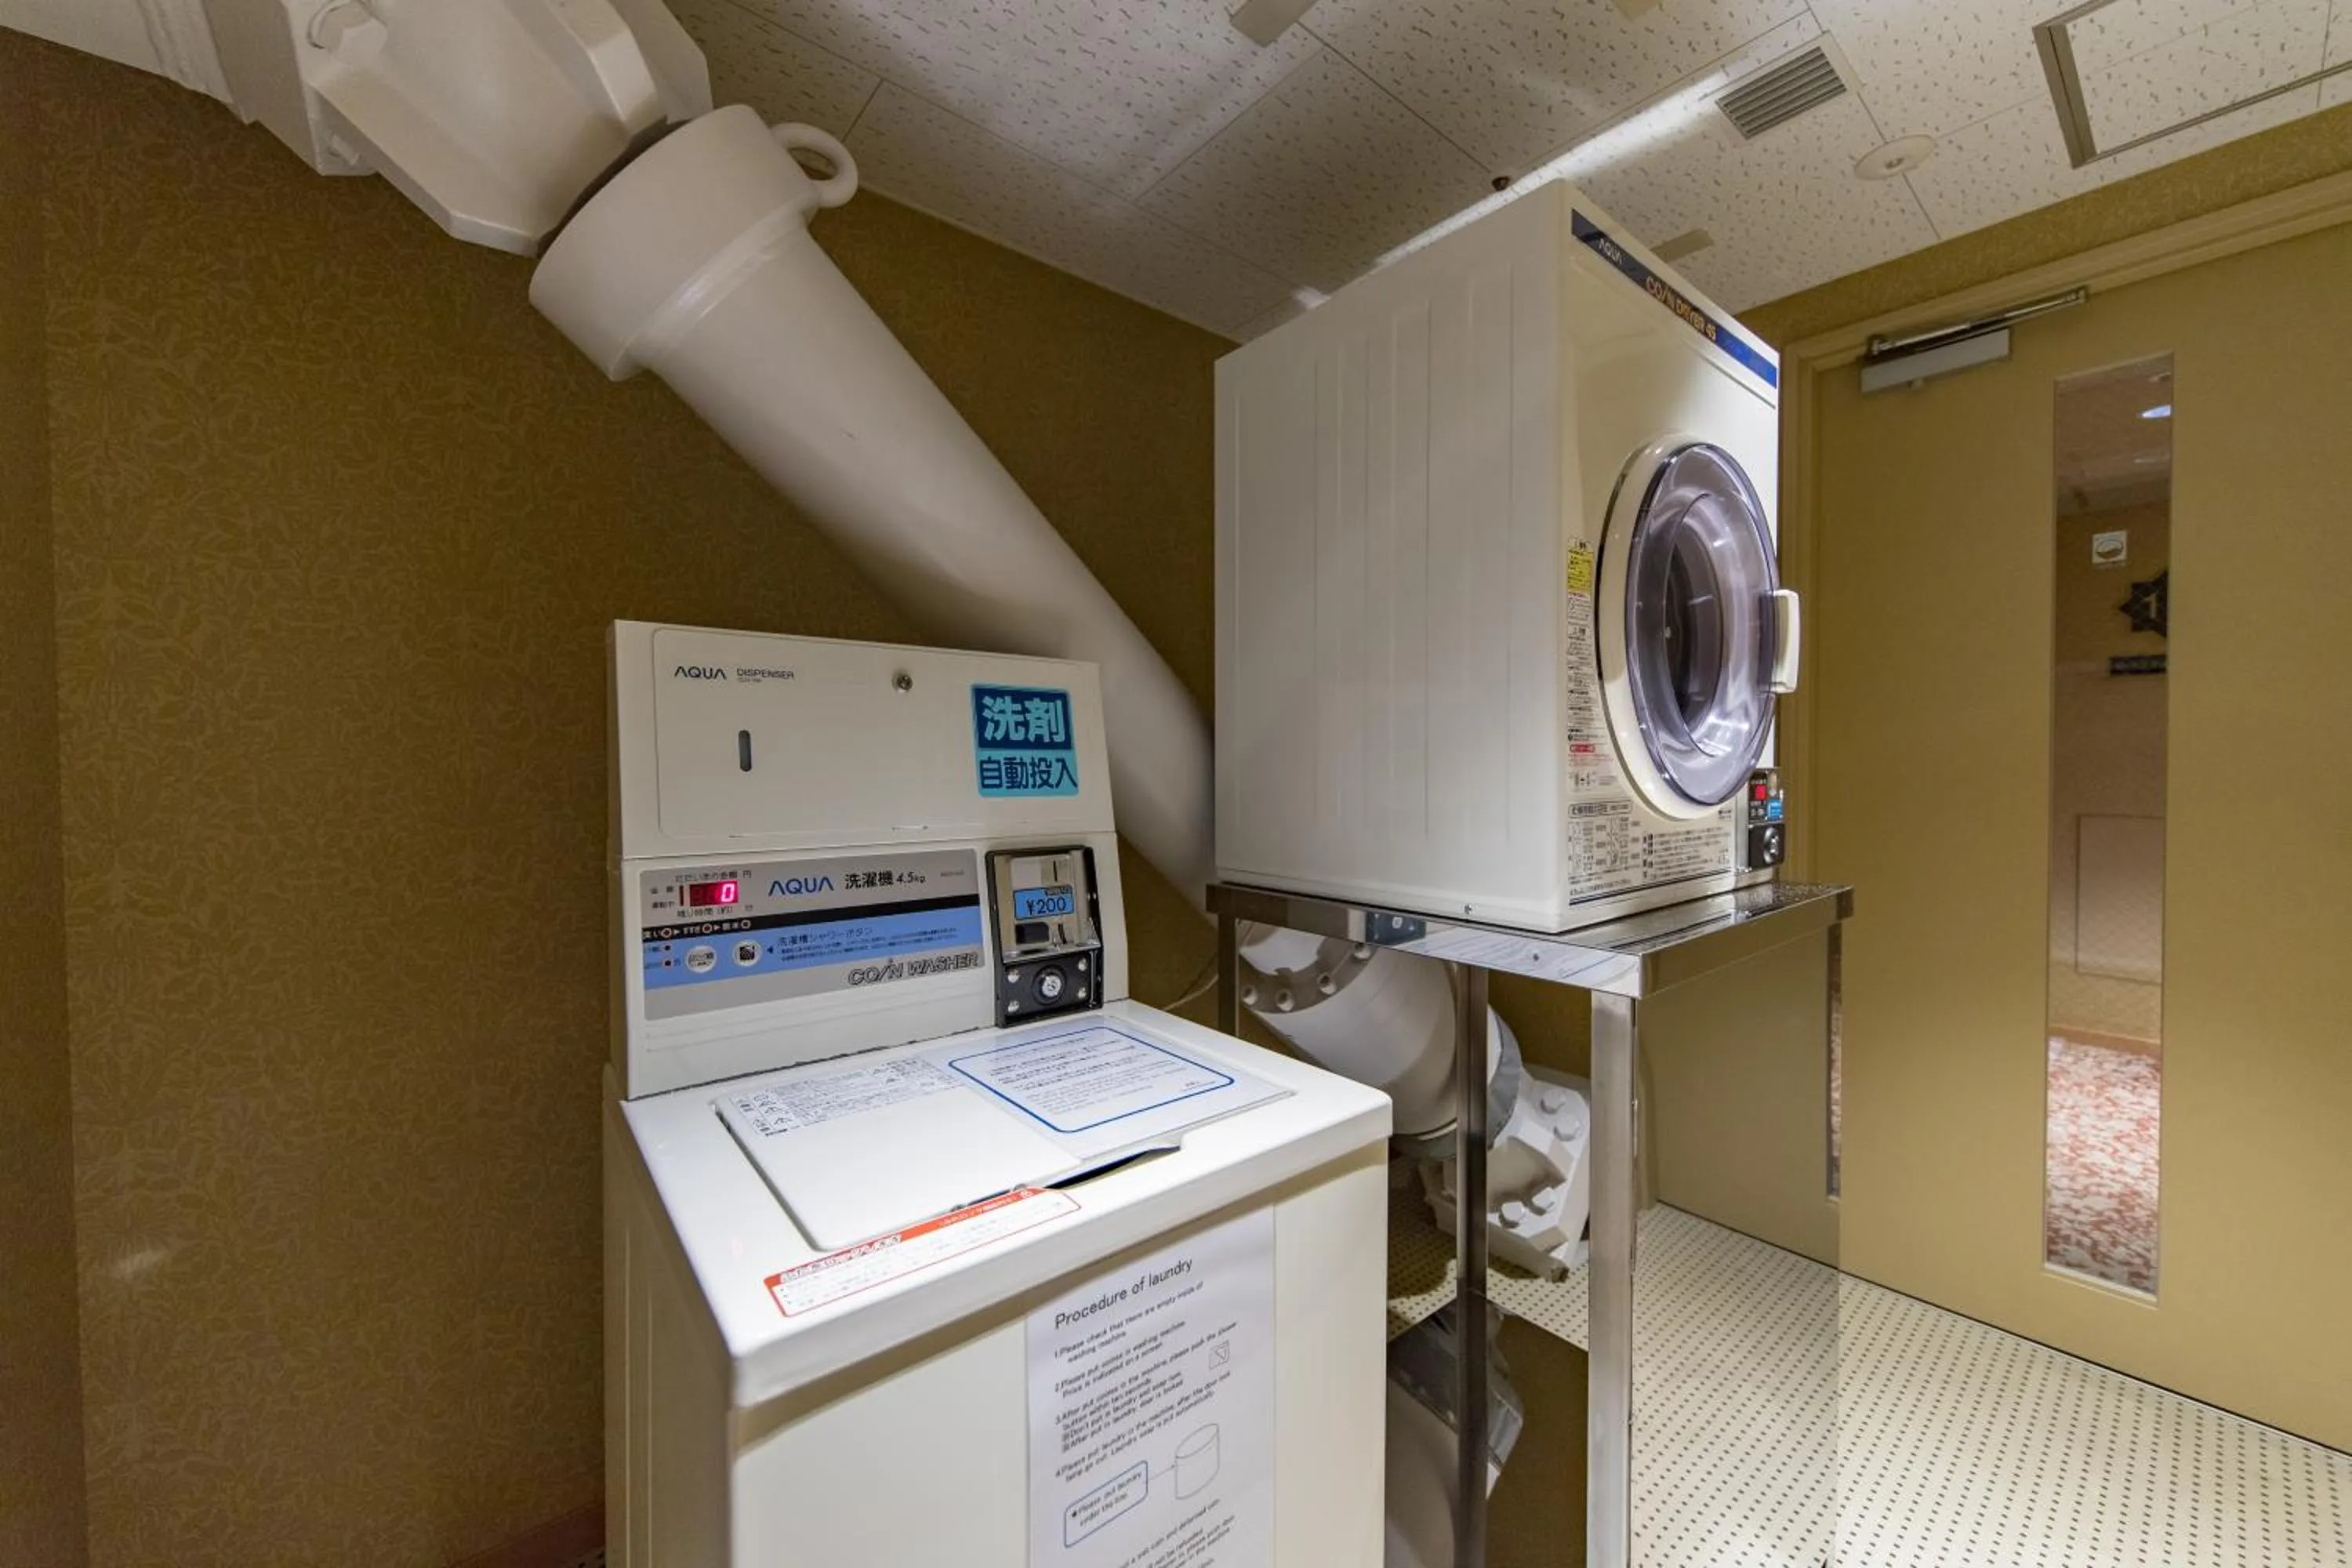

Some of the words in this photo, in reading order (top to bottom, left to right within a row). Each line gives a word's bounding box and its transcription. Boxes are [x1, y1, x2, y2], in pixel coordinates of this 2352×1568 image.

[674, 666, 727, 681] AQUA
[736, 667, 794, 680] DISPENSER
[982, 695, 1065, 742] 洗剤
[979, 756, 1079, 789] 自動投入
[720, 884, 735, 902] 0
[768, 877, 833, 897] AQUA
[844, 871, 894, 890] 洗濯機
[1026, 896, 1067, 915] ¥200
[907, 952, 979, 976] WASHER
[1054, 1289, 1128, 1330] Procedure
[1132, 1276, 1145, 1294] of
[1149, 1258, 1193, 1288] laundry
